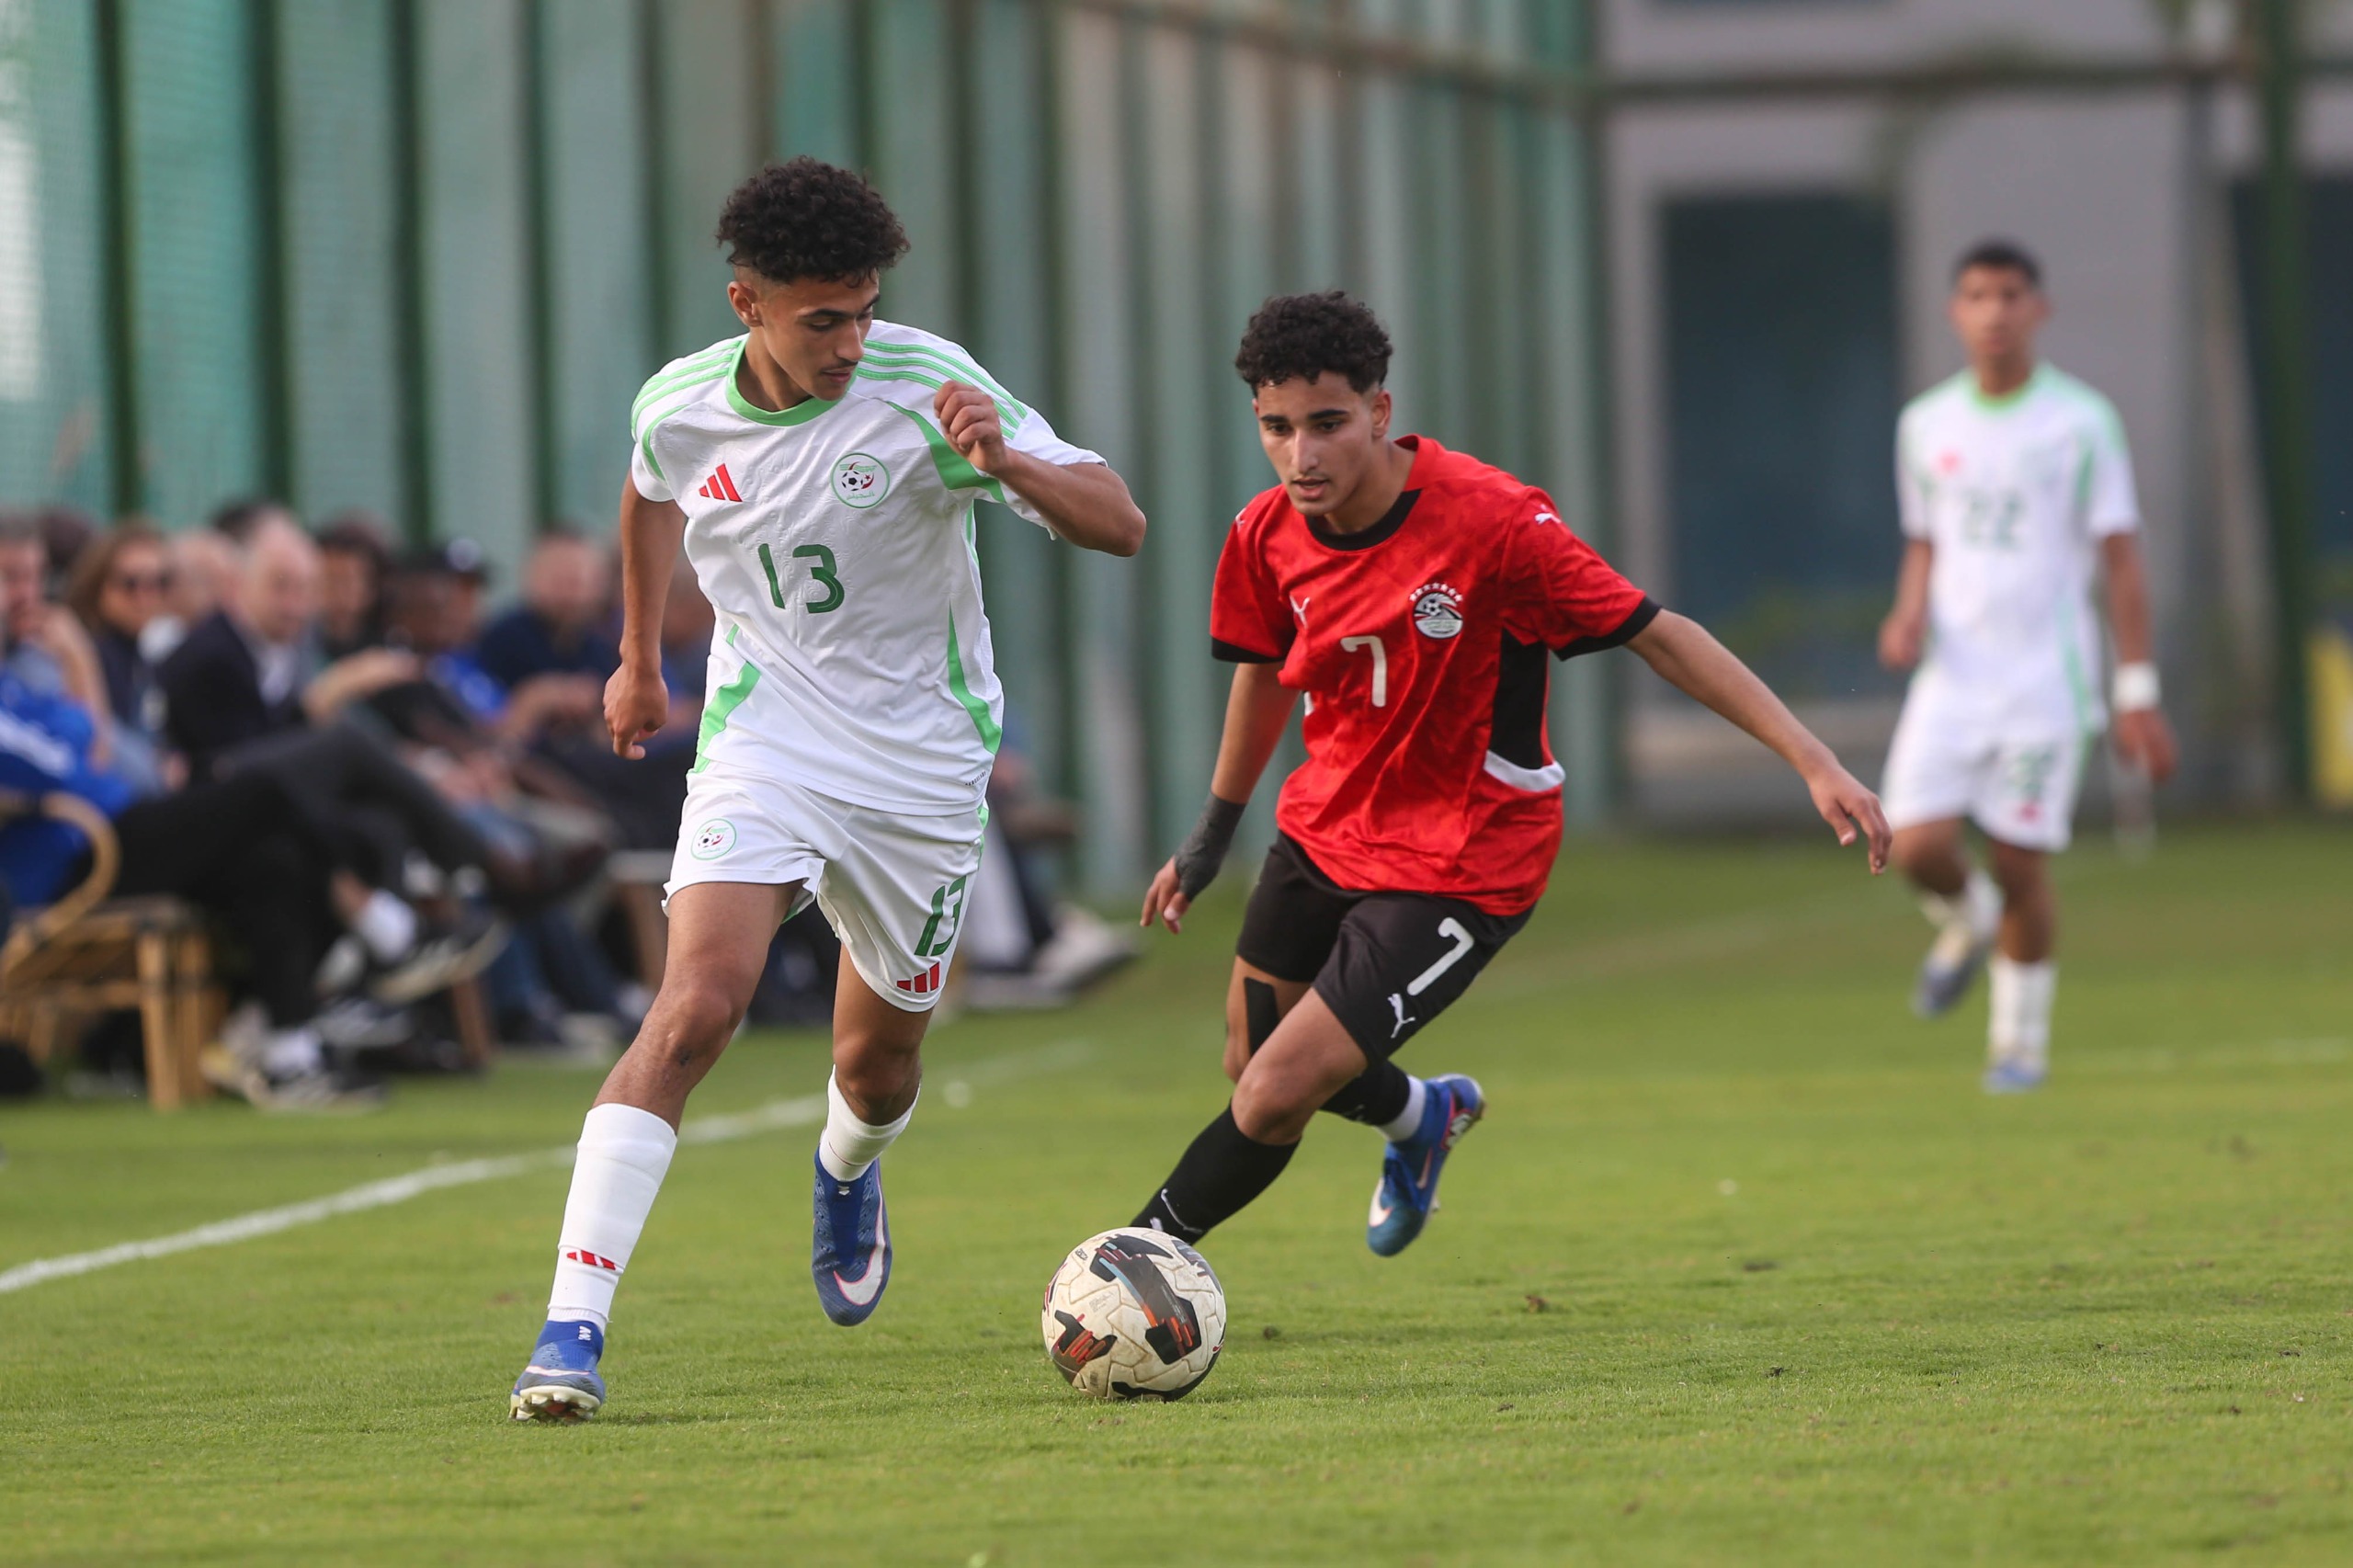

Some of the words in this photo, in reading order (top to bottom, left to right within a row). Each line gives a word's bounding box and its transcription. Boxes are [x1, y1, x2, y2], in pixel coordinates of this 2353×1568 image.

[1960, 488, 2025, 551] 22
[757, 542, 846, 614] 13
[1340, 635, 1387, 709] 7
[914, 875, 967, 957] 13
[1406, 916, 1475, 996] 7
